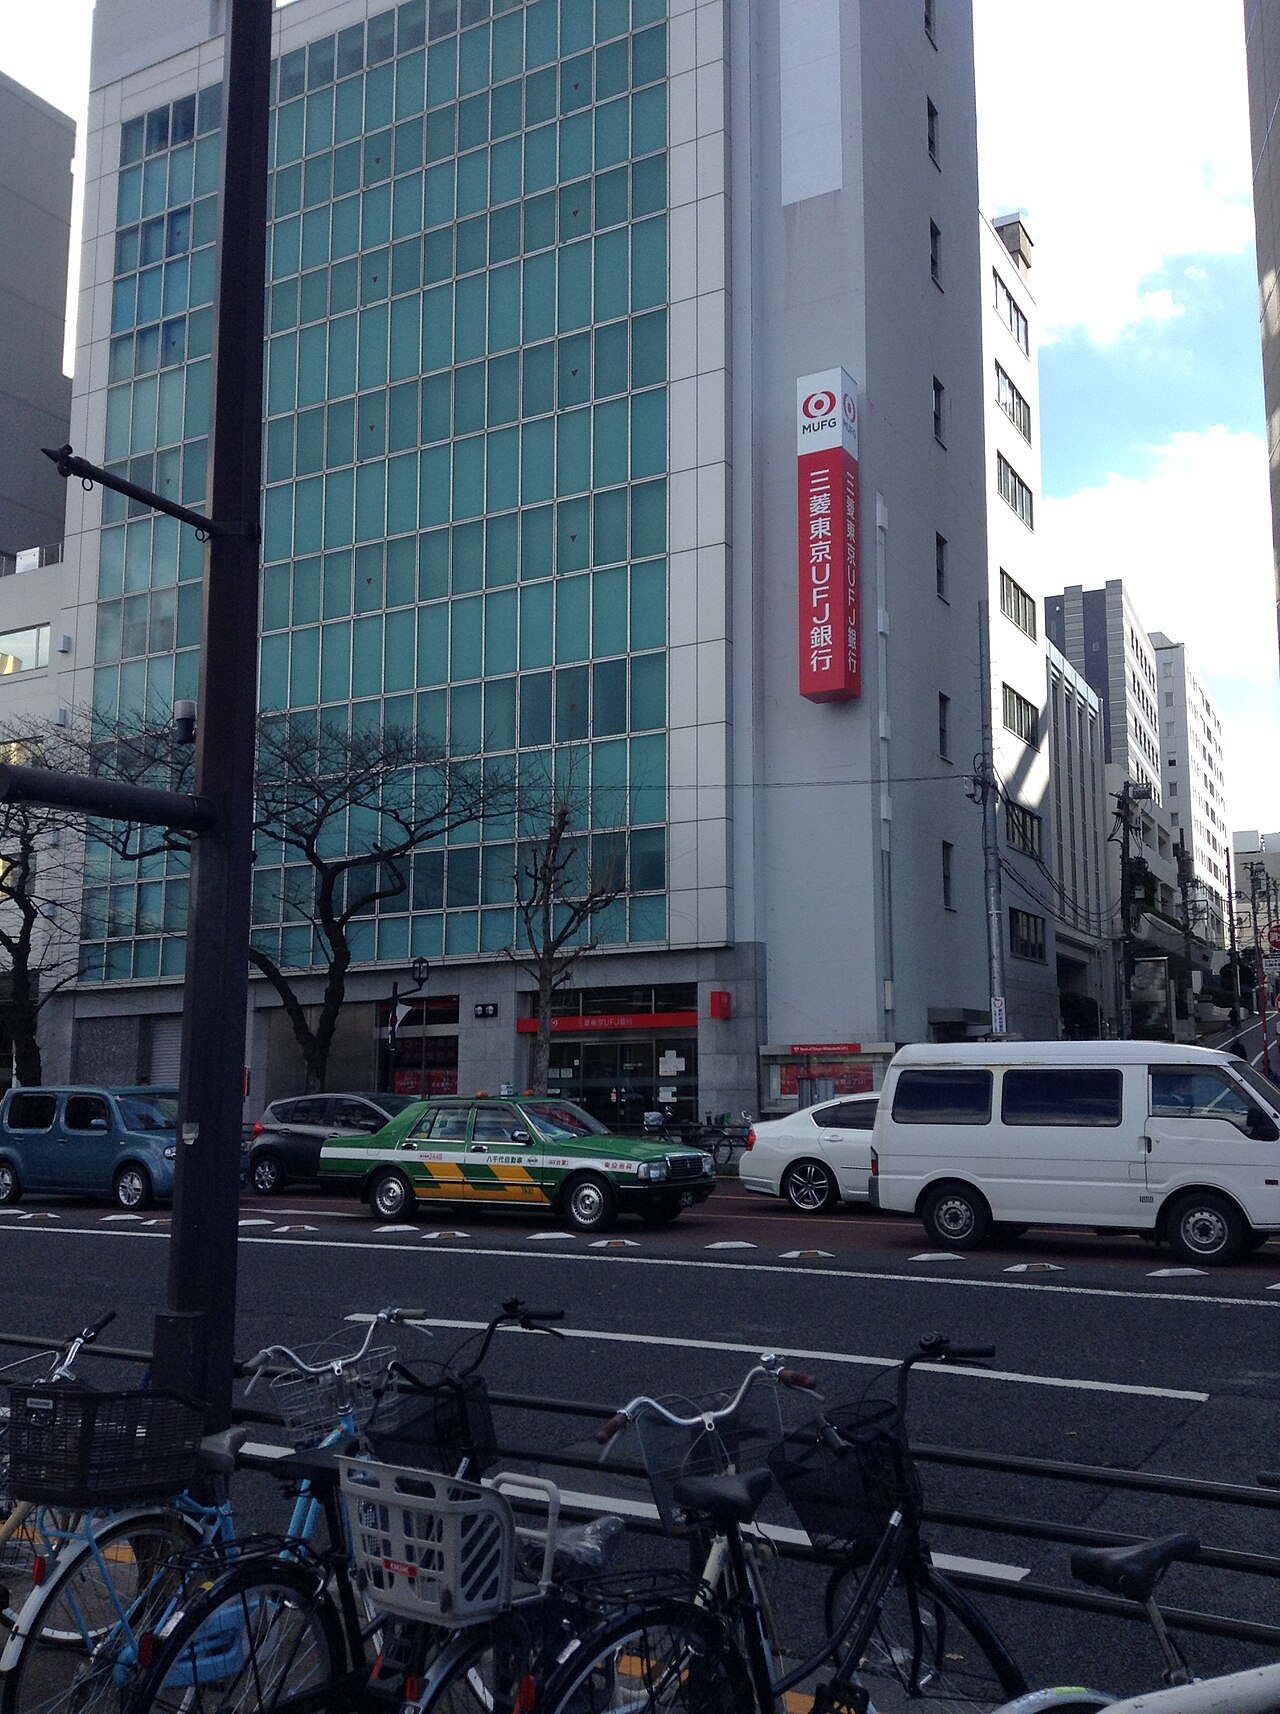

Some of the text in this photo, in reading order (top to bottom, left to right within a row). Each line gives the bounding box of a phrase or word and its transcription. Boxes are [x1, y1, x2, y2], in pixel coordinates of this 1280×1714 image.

[802, 418, 837, 435] MUFG
[809, 468, 833, 673] 三菱東京UFJ銀行
